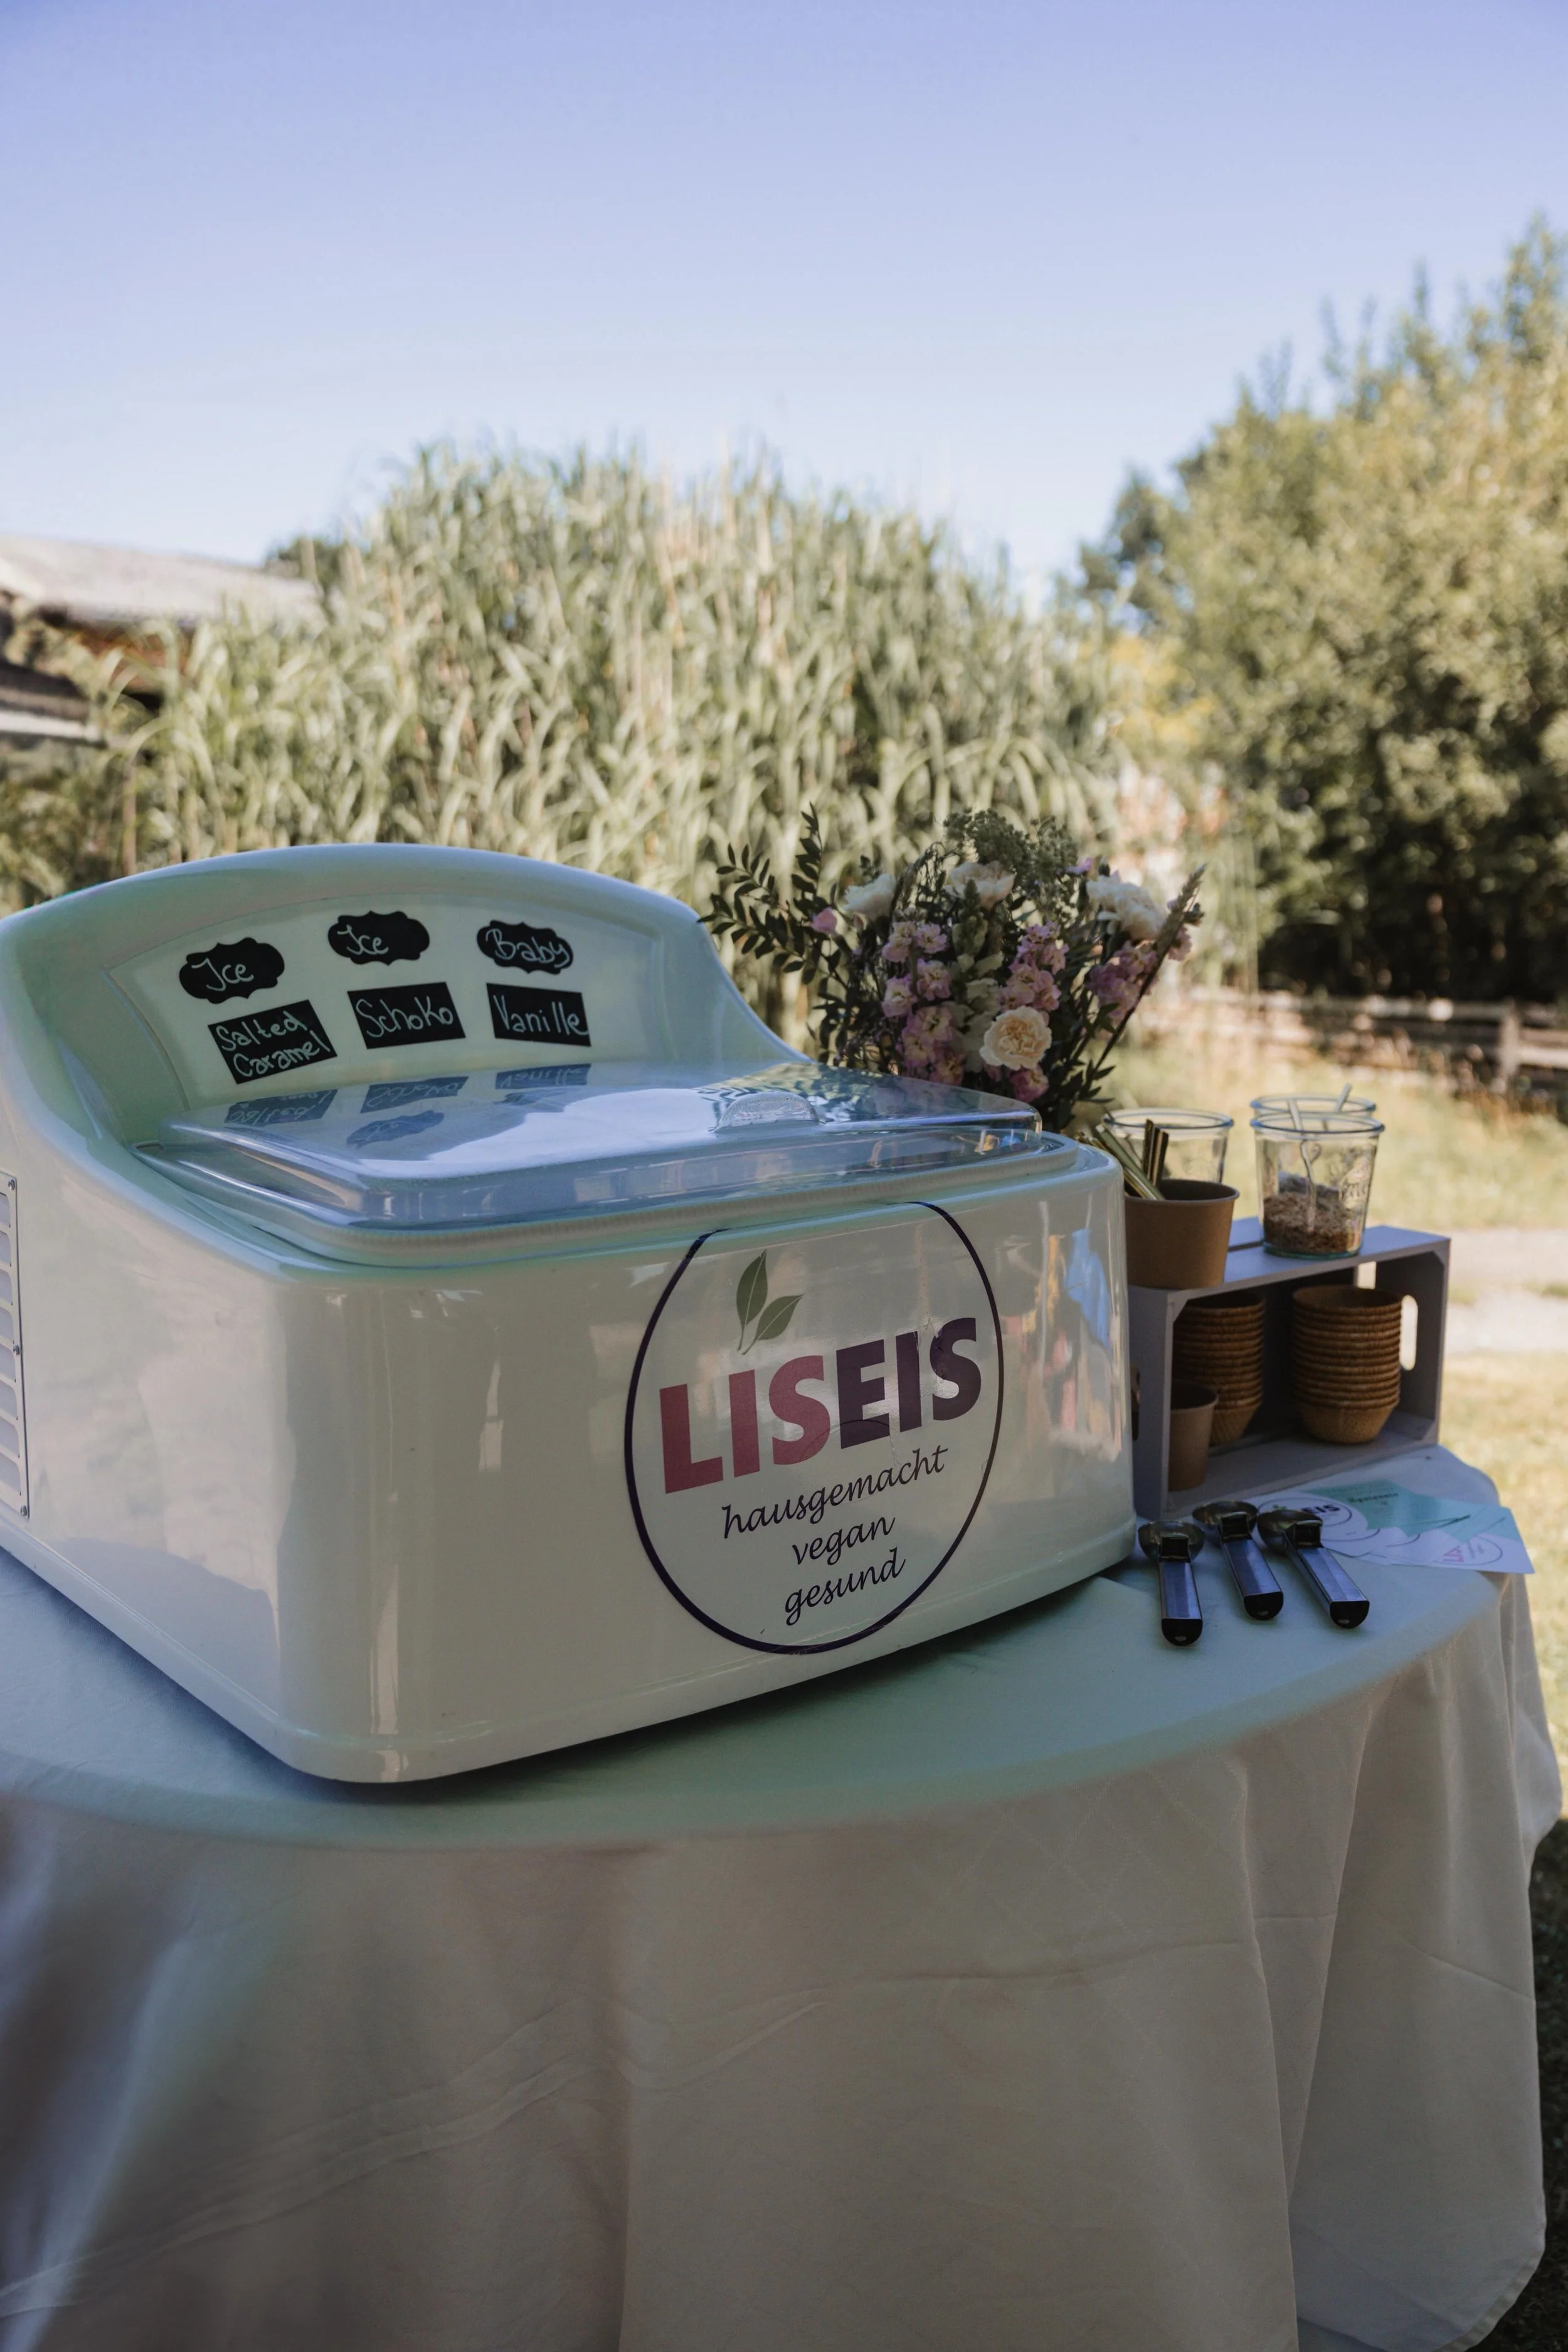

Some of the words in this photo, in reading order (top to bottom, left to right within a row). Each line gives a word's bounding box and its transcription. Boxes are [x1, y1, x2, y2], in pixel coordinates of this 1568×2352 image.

[337, 924, 389, 955] Ice
[485, 929, 570, 968] Baby
[191, 957, 254, 991] Ice
[216, 1010, 308, 1051] Salted
[493, 994, 590, 1035] Vanille
[233, 1030, 331, 1077] Caramel
[659, 1317, 982, 1494] LISEIS
[721, 1444, 948, 1539] hausgemacht
[792, 1514, 896, 1565] vegan
[784, 1547, 906, 1626] gesund
